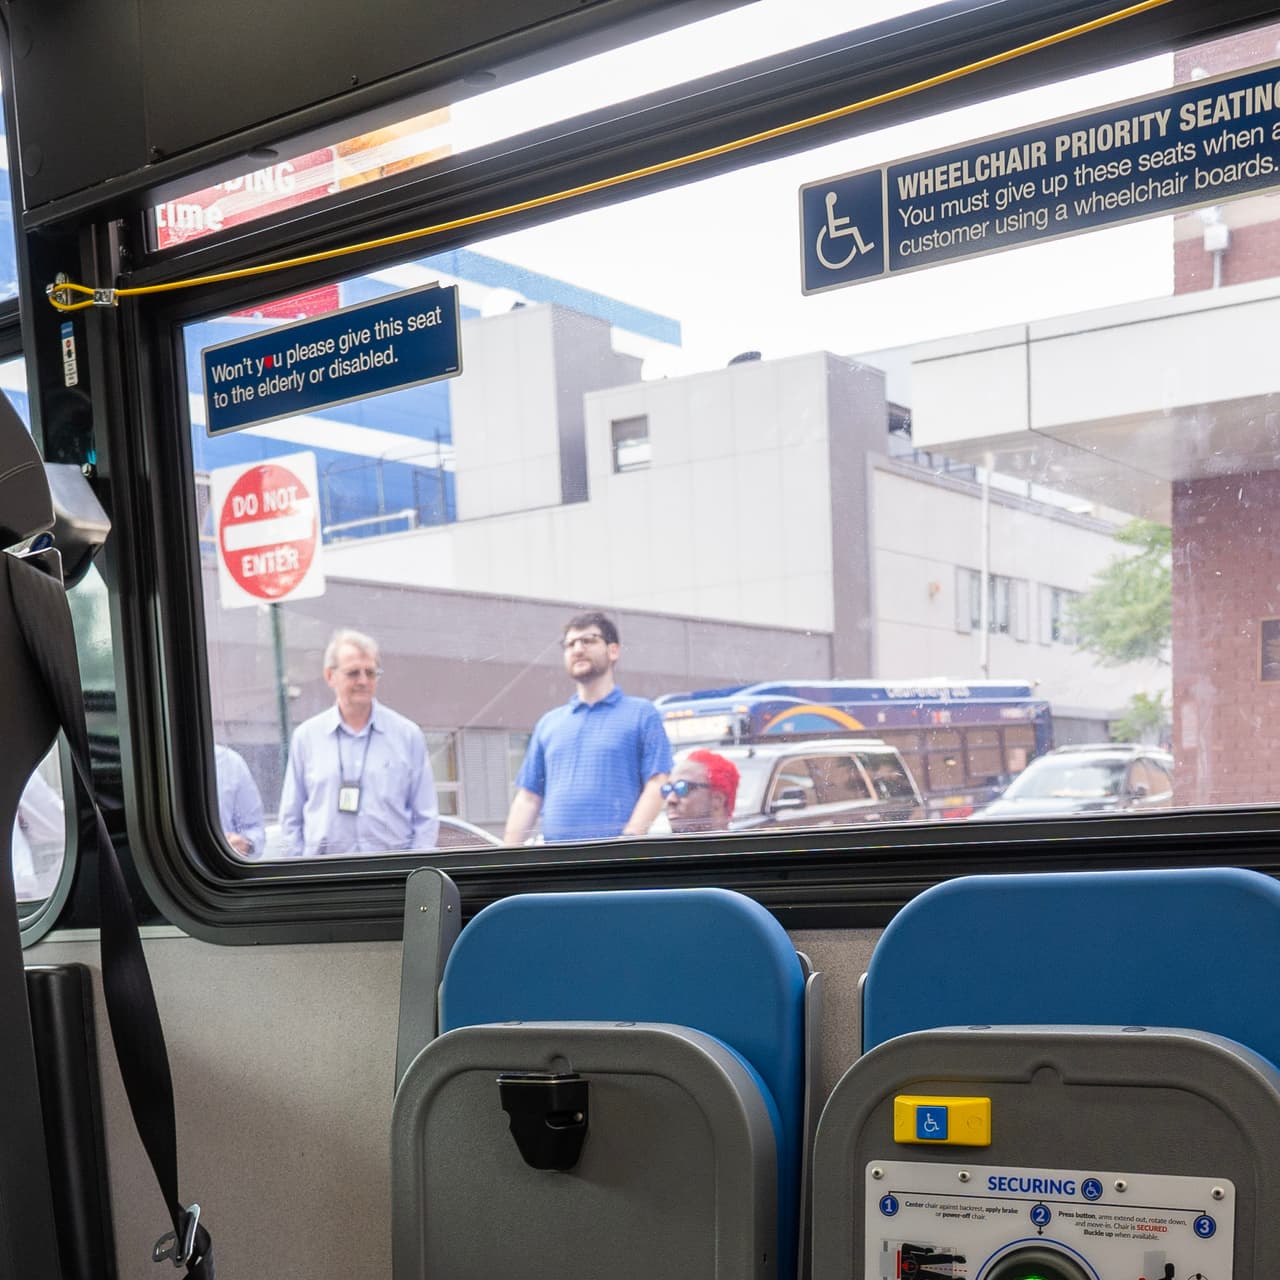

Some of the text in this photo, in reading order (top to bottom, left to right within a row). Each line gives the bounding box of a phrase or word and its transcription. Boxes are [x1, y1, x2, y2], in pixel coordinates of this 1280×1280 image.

[897, 140, 1047, 200] WHEELCHAIR
[1055, 108, 1172, 162] PRIORITY
[898, 204, 935, 227] You
[941, 194, 989, 219] must
[995, 181, 1036, 211] give
[1041, 174, 1068, 197] up
[1074, 159, 1132, 187] these
[1138, 142, 1196, 172] seats
[1203, 126, 1264, 156] when
[899, 153, 1279, 256] customer using a wheelchair boards.
[211, 357, 253, 384] Won't
[286, 338, 336, 369] please
[339, 328, 371, 354] give
[374, 319, 404, 341] this
[407, 306, 443, 331] seat
[213, 344, 399, 408] to the elderly or disabled.
[232, 485, 298, 519] DO NOT
[241, 545, 299, 578] ENTER
[987, 1175, 1076, 1195] SECURING
[924, 1201, 939, 1209] chair
[939, 1203, 959, 1211] against
[959, 1203, 985, 1212] backrest,
[985, 1206, 1001, 1214] apply
[942, 1211, 971, 1219] power-off
[1058, 1210, 1075, 1218] Press
[1075, 1211, 1097, 1220] button,
[1113, 1214, 1134, 1222] extend
[1135, 1216, 1148, 1224] out,
[1148, 1217, 1167, 1225] rotate
[1168, 1217, 1187, 1226] down,
[1083, 1229, 1159, 1240] Buckle up when available.
[1086, 1221, 1112, 1230] move-in.
[1113, 1222, 1130, 1231] Chair
[1136, 1224, 1168, 1233] SECURED
